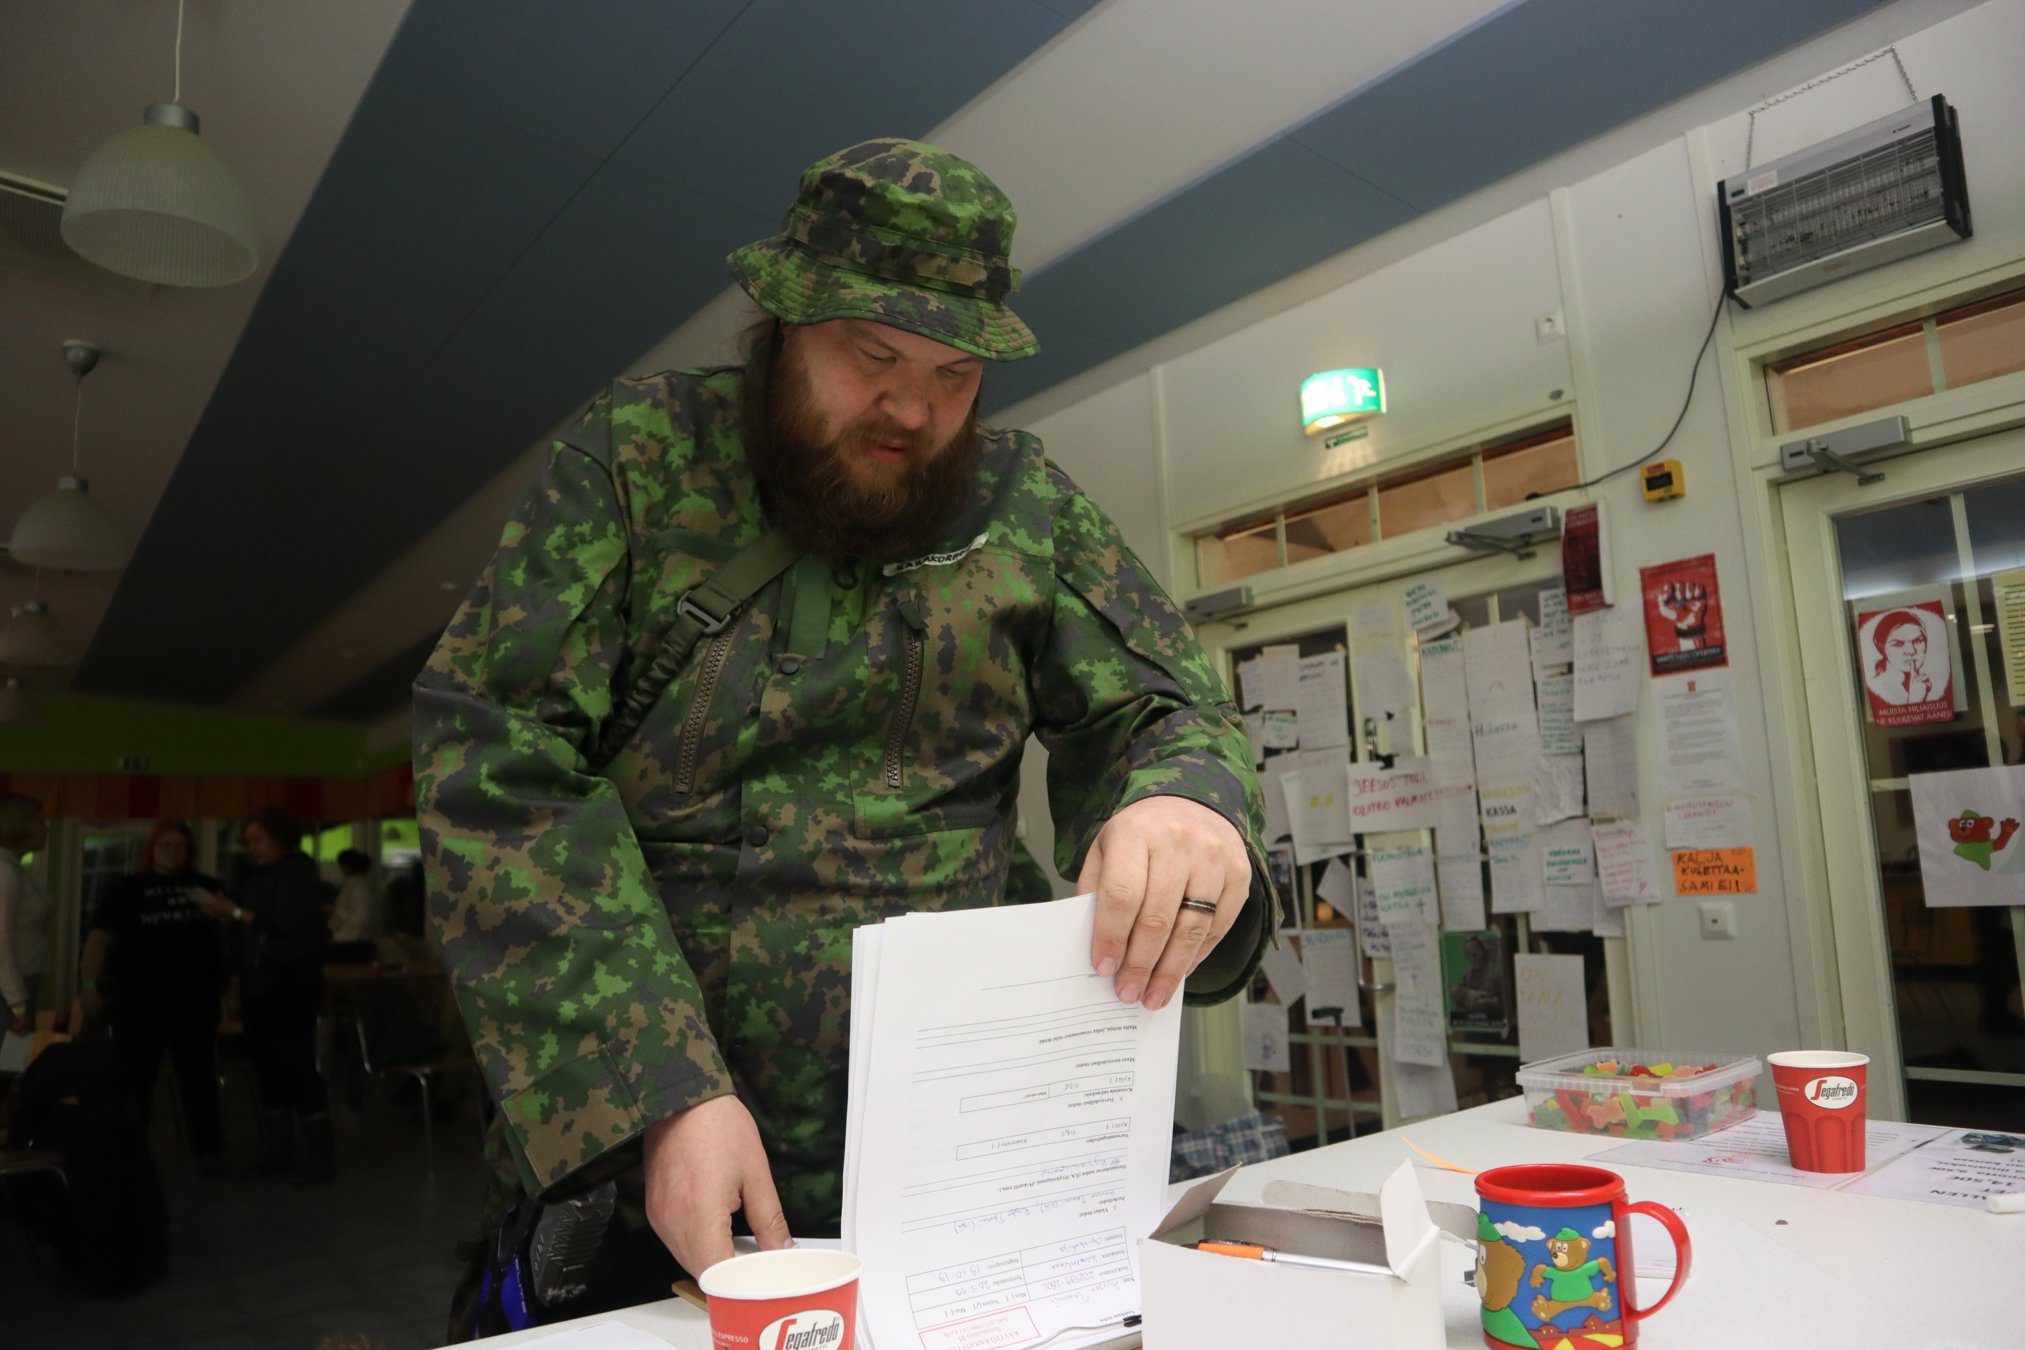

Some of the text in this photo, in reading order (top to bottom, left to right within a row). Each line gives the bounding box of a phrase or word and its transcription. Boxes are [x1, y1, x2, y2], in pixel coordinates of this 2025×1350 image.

[1879, 701, 1949, 716] MUISTA HILJAISUUS
[1485, 804, 1517, 818] KASSA
[1677, 849, 1724, 866] KALJA
[1680, 880, 1714, 893] SAMI
[1810, 1079, 1856, 1101] Segafredo
[774, 1317, 840, 1350] Segafredo
